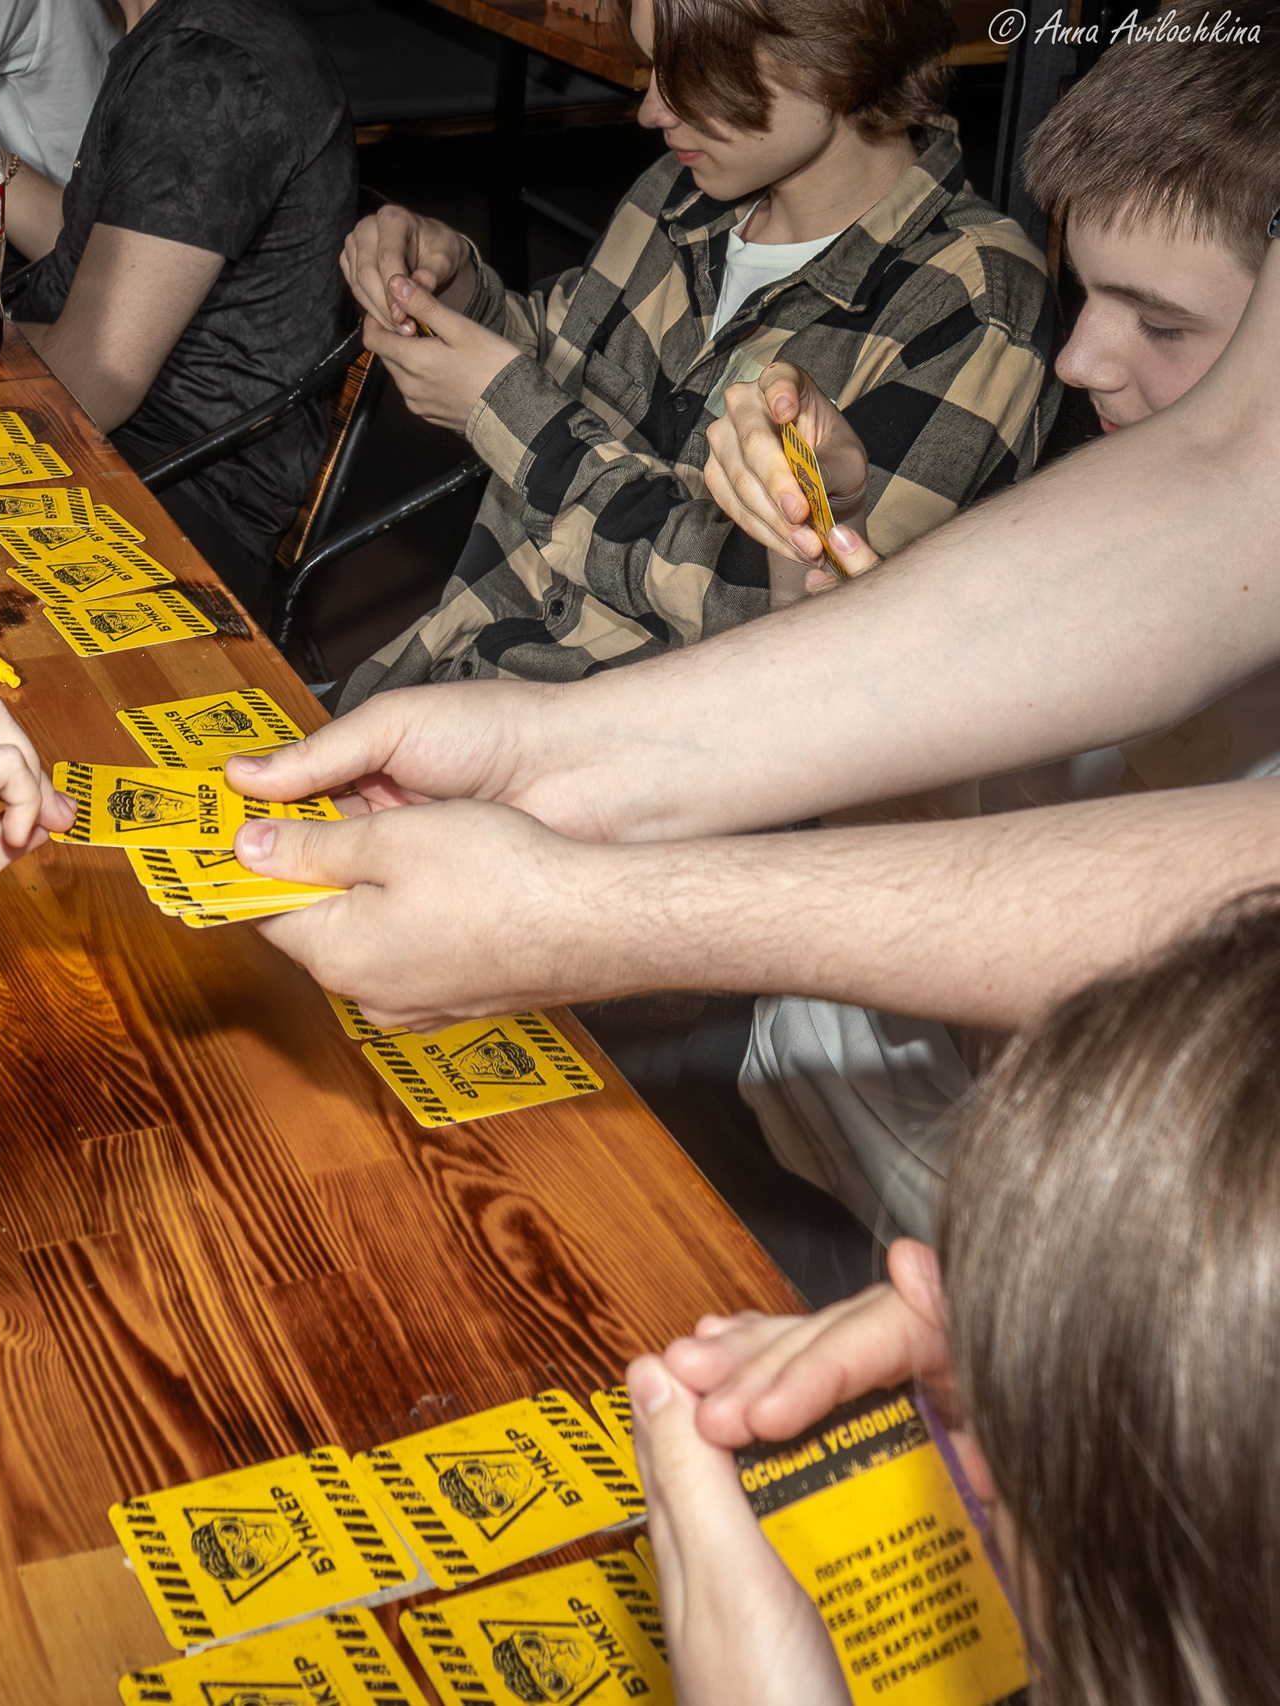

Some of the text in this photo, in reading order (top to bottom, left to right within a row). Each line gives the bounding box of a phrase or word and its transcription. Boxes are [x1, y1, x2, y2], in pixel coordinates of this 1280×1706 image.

[8, 452, 33, 475] БУНКЕР
[41, 494, 58, 519] БУНКЕР
[92, 554, 133, 582] БУНКЕР
[135, 602, 172, 632] БУНКЕР
[165, 711, 203, 747] БУНКЕР
[198, 784, 219, 834] БУНКЕР
[422, 1044, 479, 1099] БУНКЕР
[505, 1429, 584, 1507] БУНКЕР
[740, 1396, 917, 1492] ОСОБЫЕ УСЛОВИЯ
[270, 1486, 336, 1576] БУНКЕР
[815, 1546, 871, 1583] ПОЛУЧИ
[888, 1514, 937, 1545] КАРТЫ
[871, 1555, 908, 1582] ОДНУ
[913, 1527, 965, 1562] ОСТАВЬ
[827, 1607, 862, 1631] ЕБЕ,
[925, 1547, 973, 1582] ОТДАЙ
[569, 1597, 650, 1699] БУНКЕР
[844, 1611, 905, 1651] ЛЮБОМУ
[851, 1598, 980, 1676] ОБЕ КАРТЫ СРАЗУ
[293, 1656, 340, 1706] КЕР
[871, 1625, 982, 1695] ОТКРЫВАЮТСЯ
